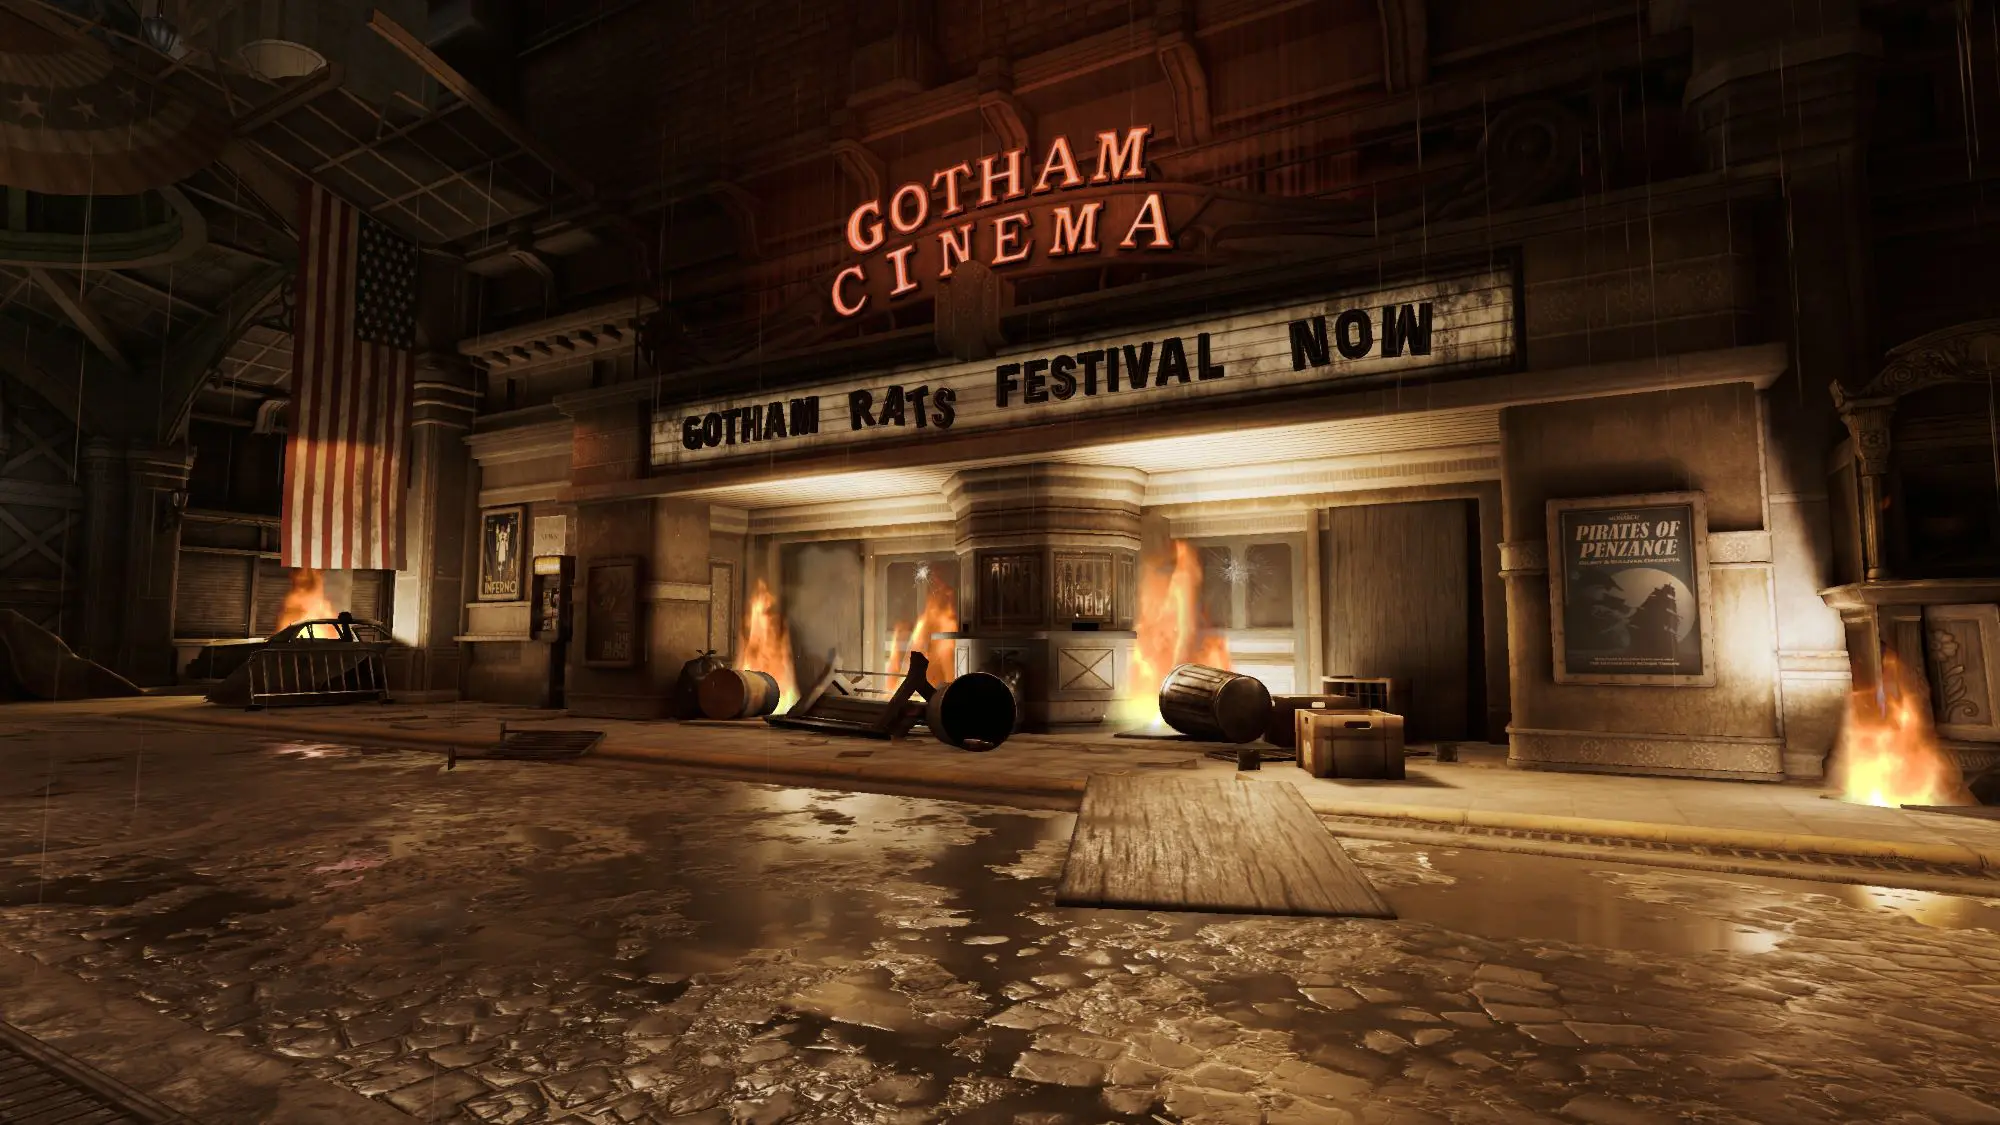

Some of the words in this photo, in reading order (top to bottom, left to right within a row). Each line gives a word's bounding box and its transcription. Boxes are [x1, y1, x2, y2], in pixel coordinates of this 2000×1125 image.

[846, 123, 1153, 254] GOTHAM
[831, 191, 1174, 317] CINEMA
[681, 395, 820, 450] GOTHAM
[848, 384, 957, 430] RATS
[996, 332, 1226, 407] FESTIVAL
[1288, 302, 1433, 372] NOW
[1575, 521, 1650, 541] PIRATES
[1655, 520, 1681, 538] OF
[1579, 538, 1678, 558] PENZANCE
[484, 580, 516, 594] INFERNO
